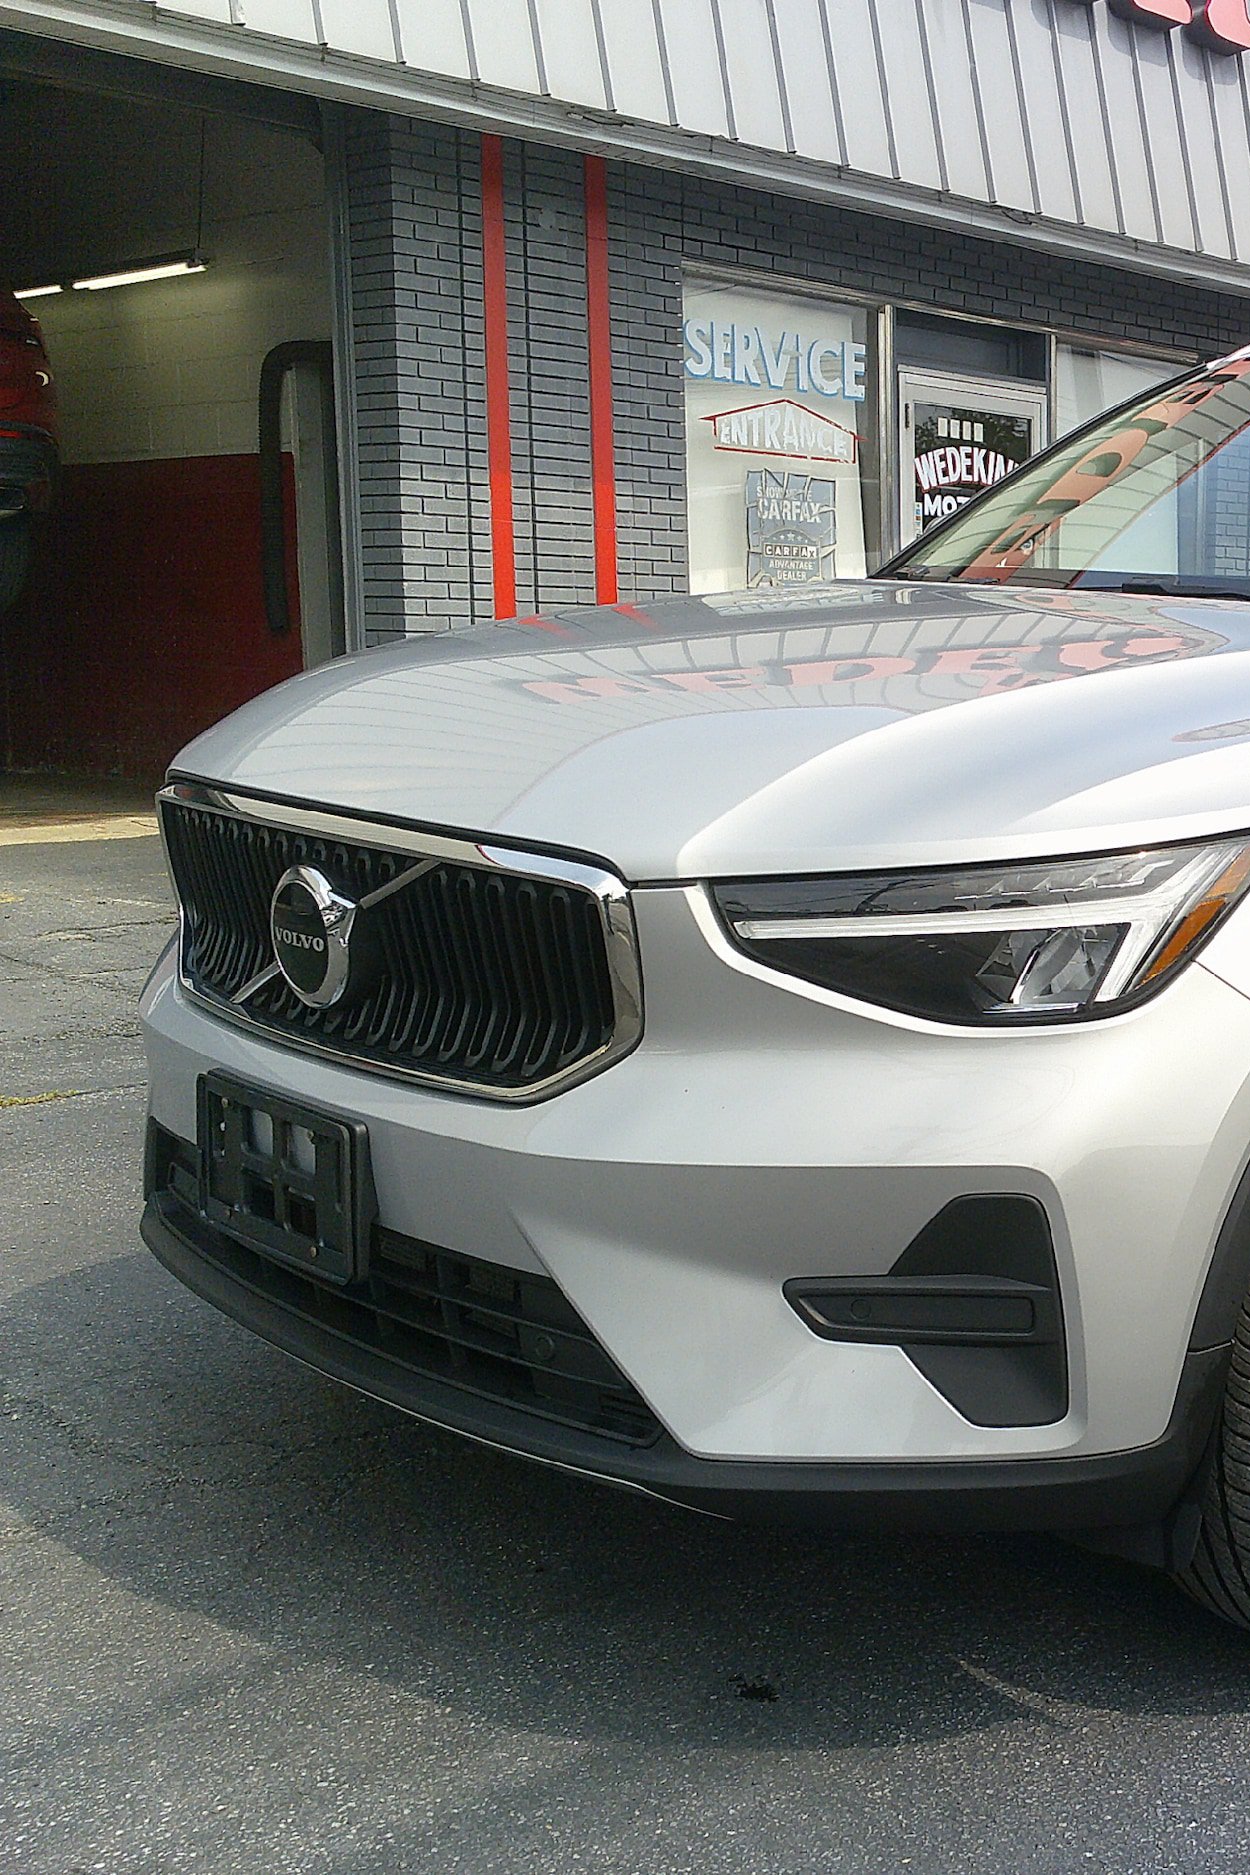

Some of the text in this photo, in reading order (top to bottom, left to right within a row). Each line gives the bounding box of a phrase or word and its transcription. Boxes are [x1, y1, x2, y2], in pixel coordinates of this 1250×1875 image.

[684, 319, 866, 401] SERVICE
[719, 403, 848, 456] ENTRANCE
[914, 445, 1020, 494] WEDEKIN
[757, 498, 822, 523] CARFAX
[764, 545, 817, 559] CARFAX
[769, 560, 814, 571] ADVANTAGE
[777, 571, 807, 581] DEALER
[275, 926, 325, 952] VOLVO
